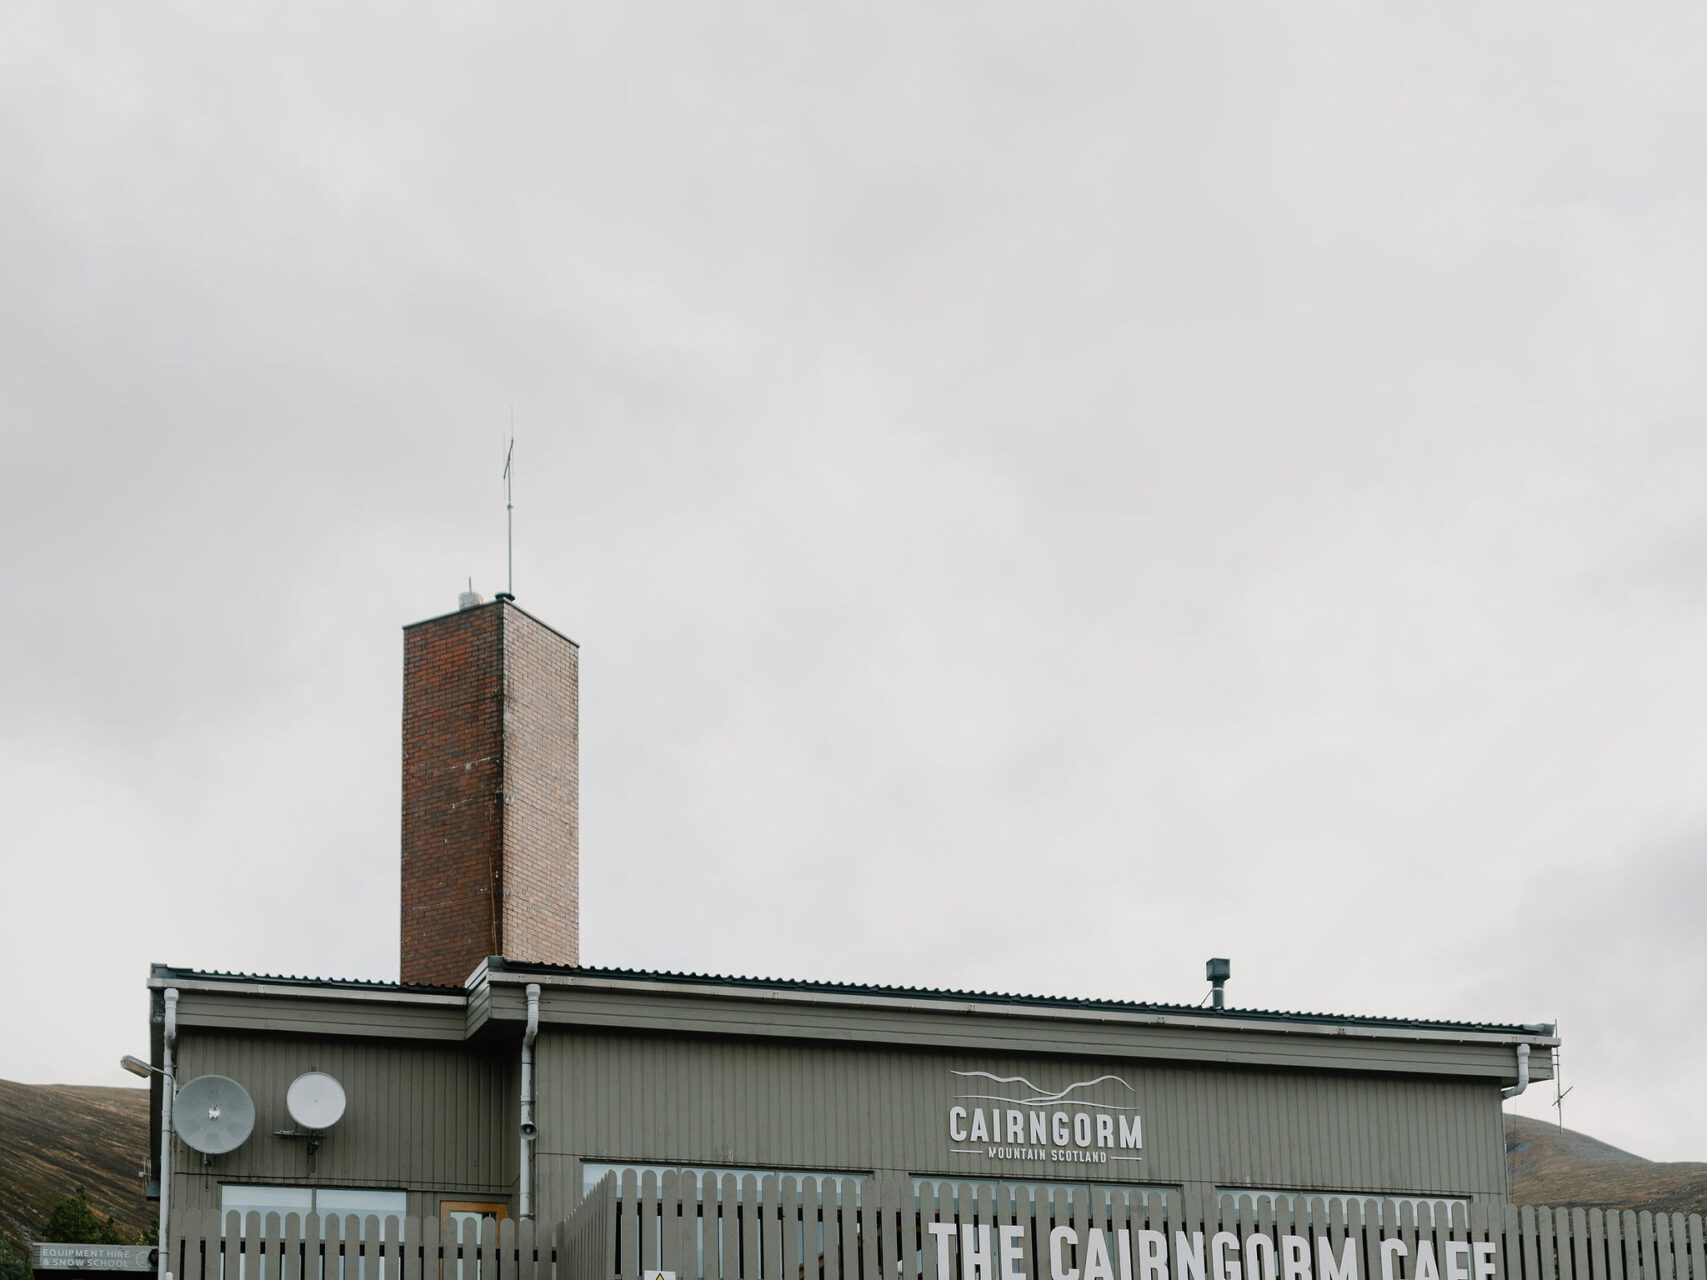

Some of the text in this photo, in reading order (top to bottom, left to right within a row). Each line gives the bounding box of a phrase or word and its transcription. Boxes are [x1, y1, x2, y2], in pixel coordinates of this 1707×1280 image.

[950, 1106, 1143, 1149] CAIRNGORM
[988, 1146, 1107, 1163] MOUNTAIN SCOTLAND
[43, 1249, 130, 1258] EQUIPMENT HIRE
[53, 1259, 85, 1267] SNOW
[87, 1259, 128, 1268] SCHOOL
